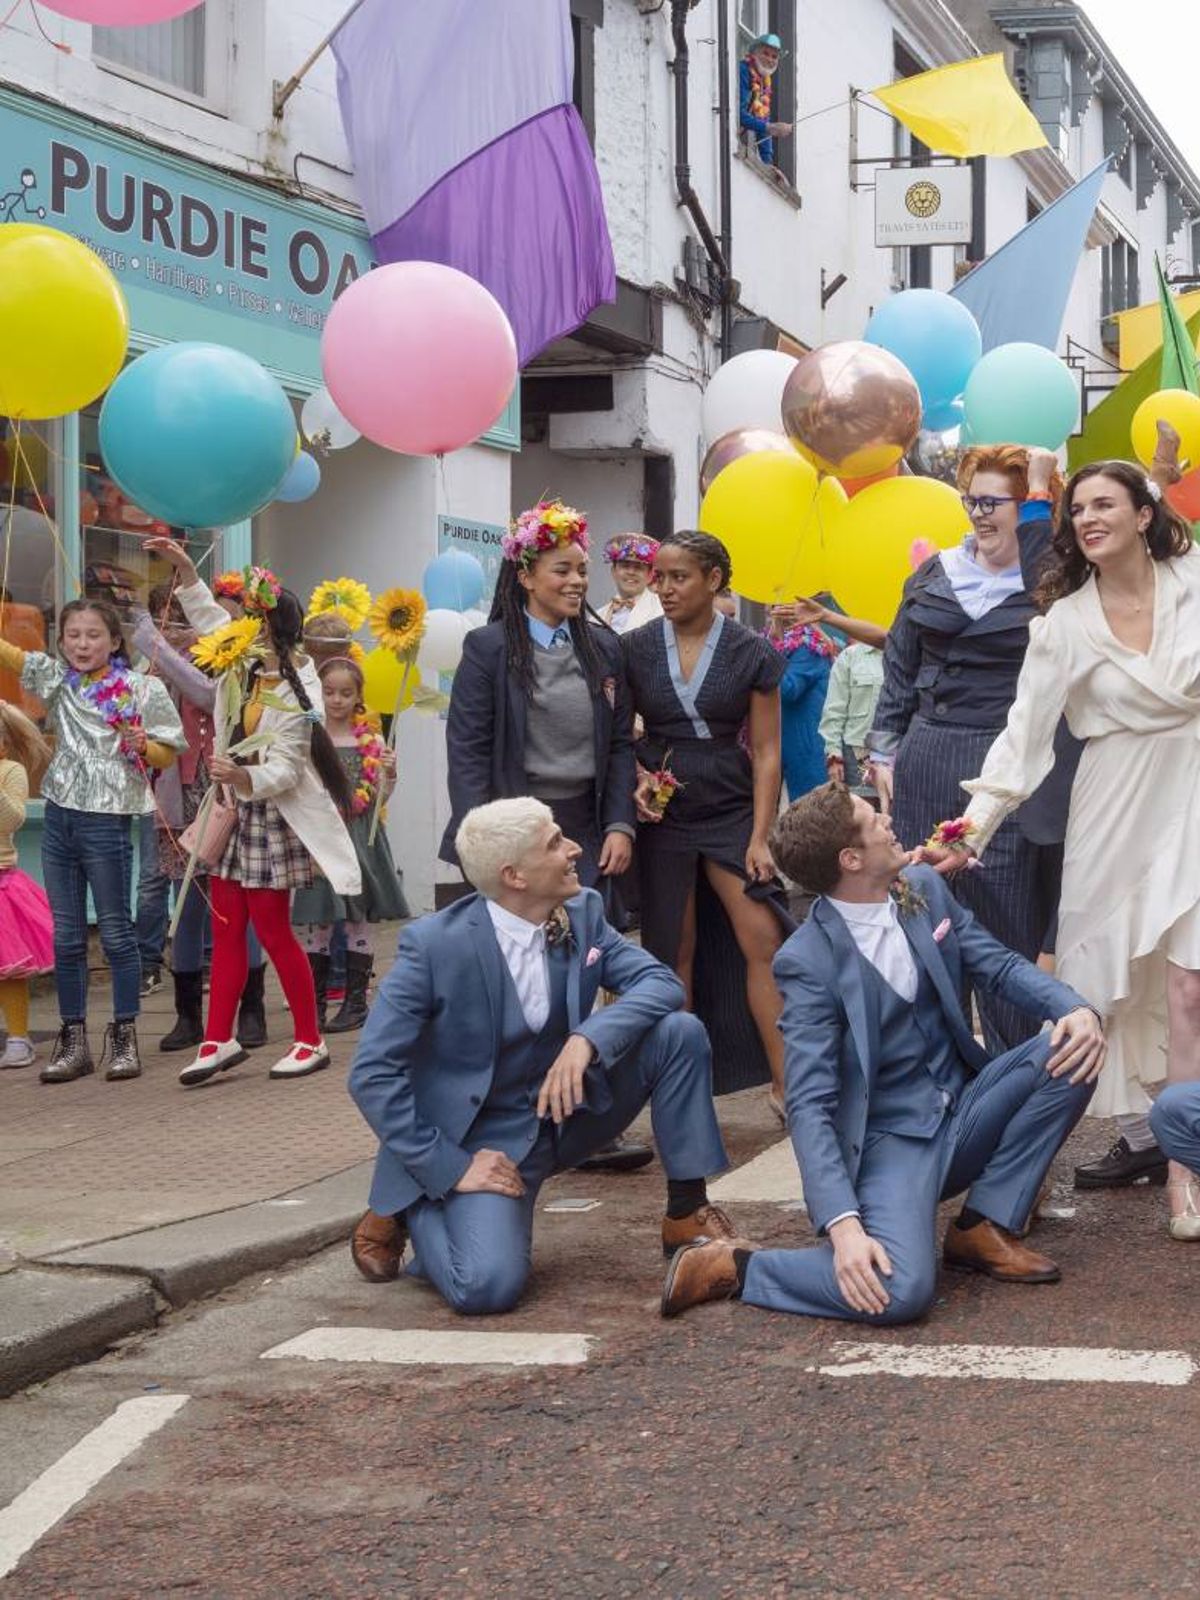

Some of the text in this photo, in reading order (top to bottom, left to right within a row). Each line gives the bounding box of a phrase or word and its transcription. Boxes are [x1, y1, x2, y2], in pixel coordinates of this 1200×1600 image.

[51, 140, 377, 302] PURDIE OA
[443, 522, 479, 541] PURDIE
